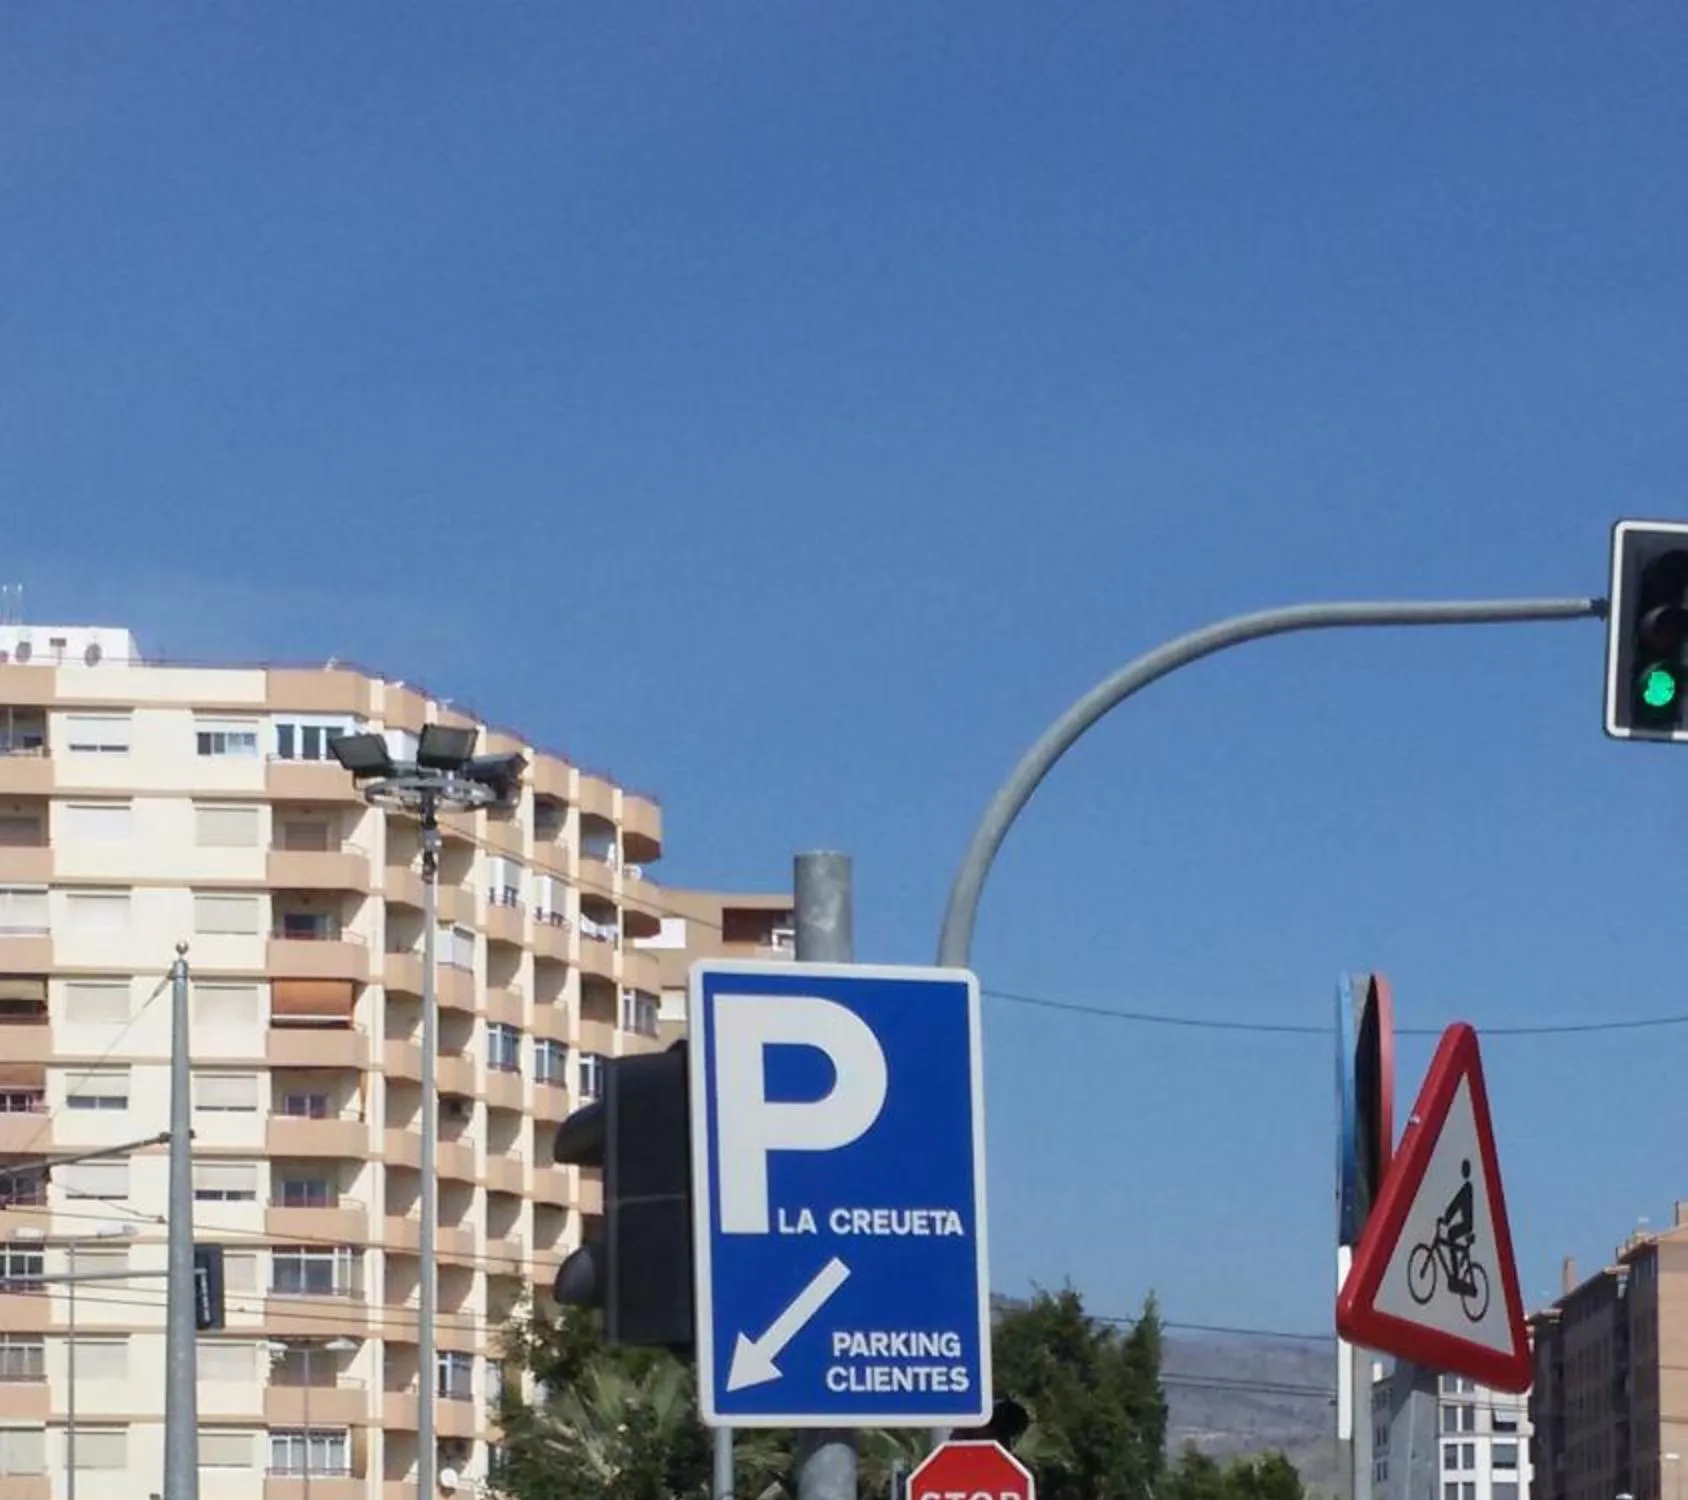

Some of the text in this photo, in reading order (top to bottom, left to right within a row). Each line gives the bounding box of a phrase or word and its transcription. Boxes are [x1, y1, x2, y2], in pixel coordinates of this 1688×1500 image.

[713, 993, 888, 1235] P
[777, 1207, 964, 1236] LA CREUETA
[832, 1331, 962, 1358] PARKING
[825, 1365, 970, 1393] CLIENTES
